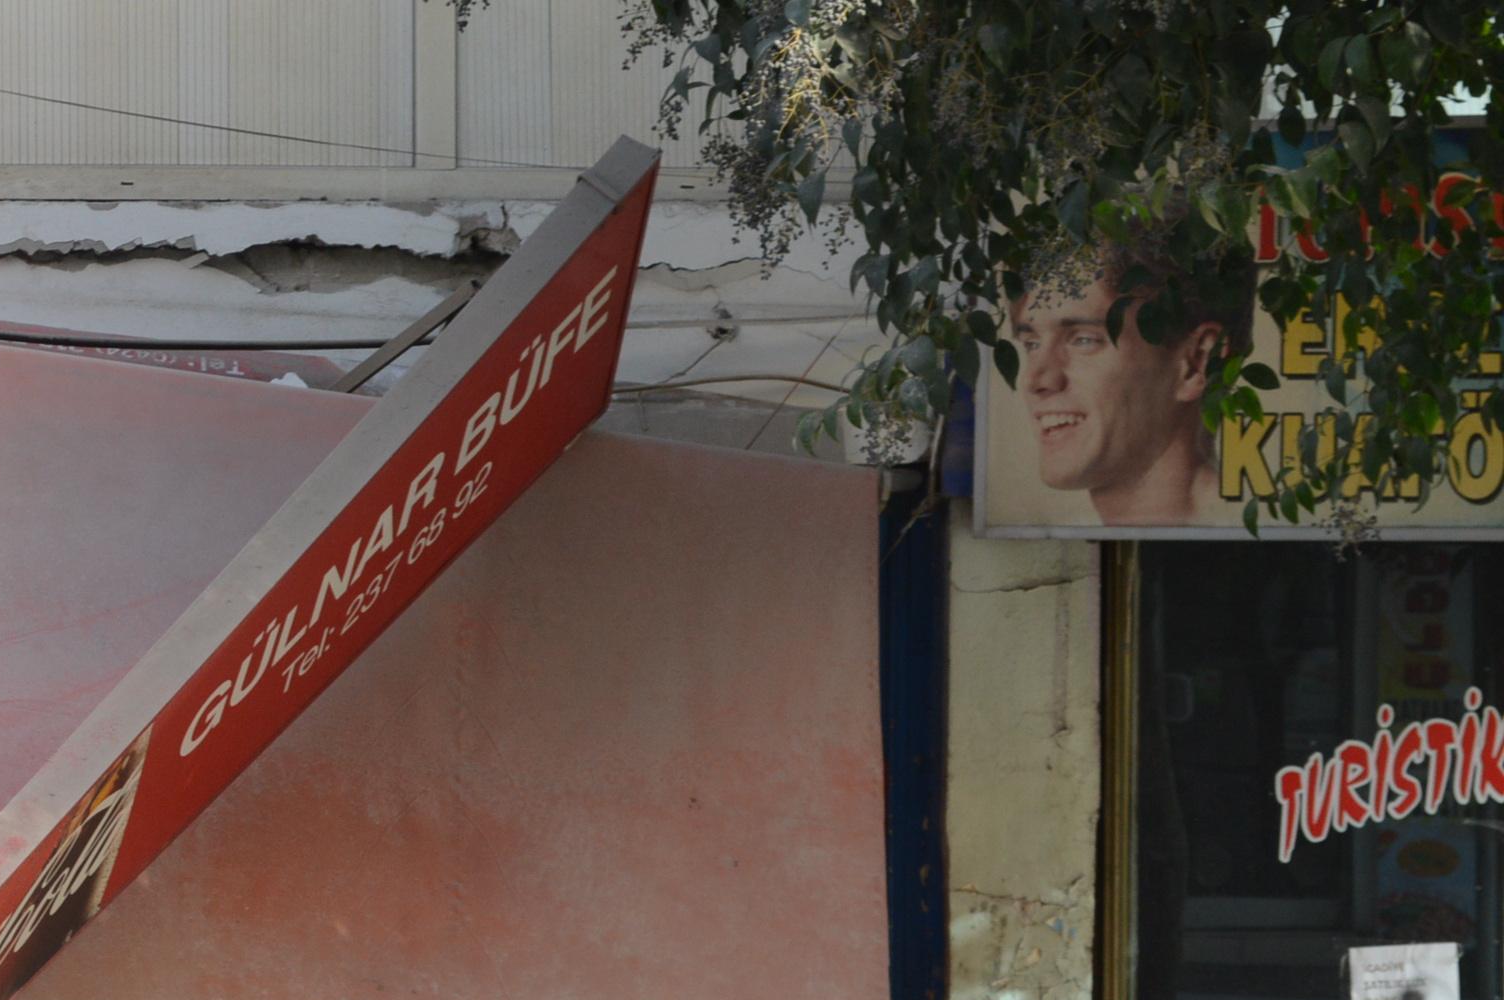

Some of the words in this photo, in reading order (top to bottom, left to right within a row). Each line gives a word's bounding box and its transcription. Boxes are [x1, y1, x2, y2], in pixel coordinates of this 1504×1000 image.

[180, 453, 445, 756] GÜLNAR
[454, 265, 617, 475] BÜFE
[341, 551, 403, 637] 237
[407, 506, 447, 566] 68
[452, 461, 493, 520] 92
[1275, 686, 1504, 863] TURİSTİK
